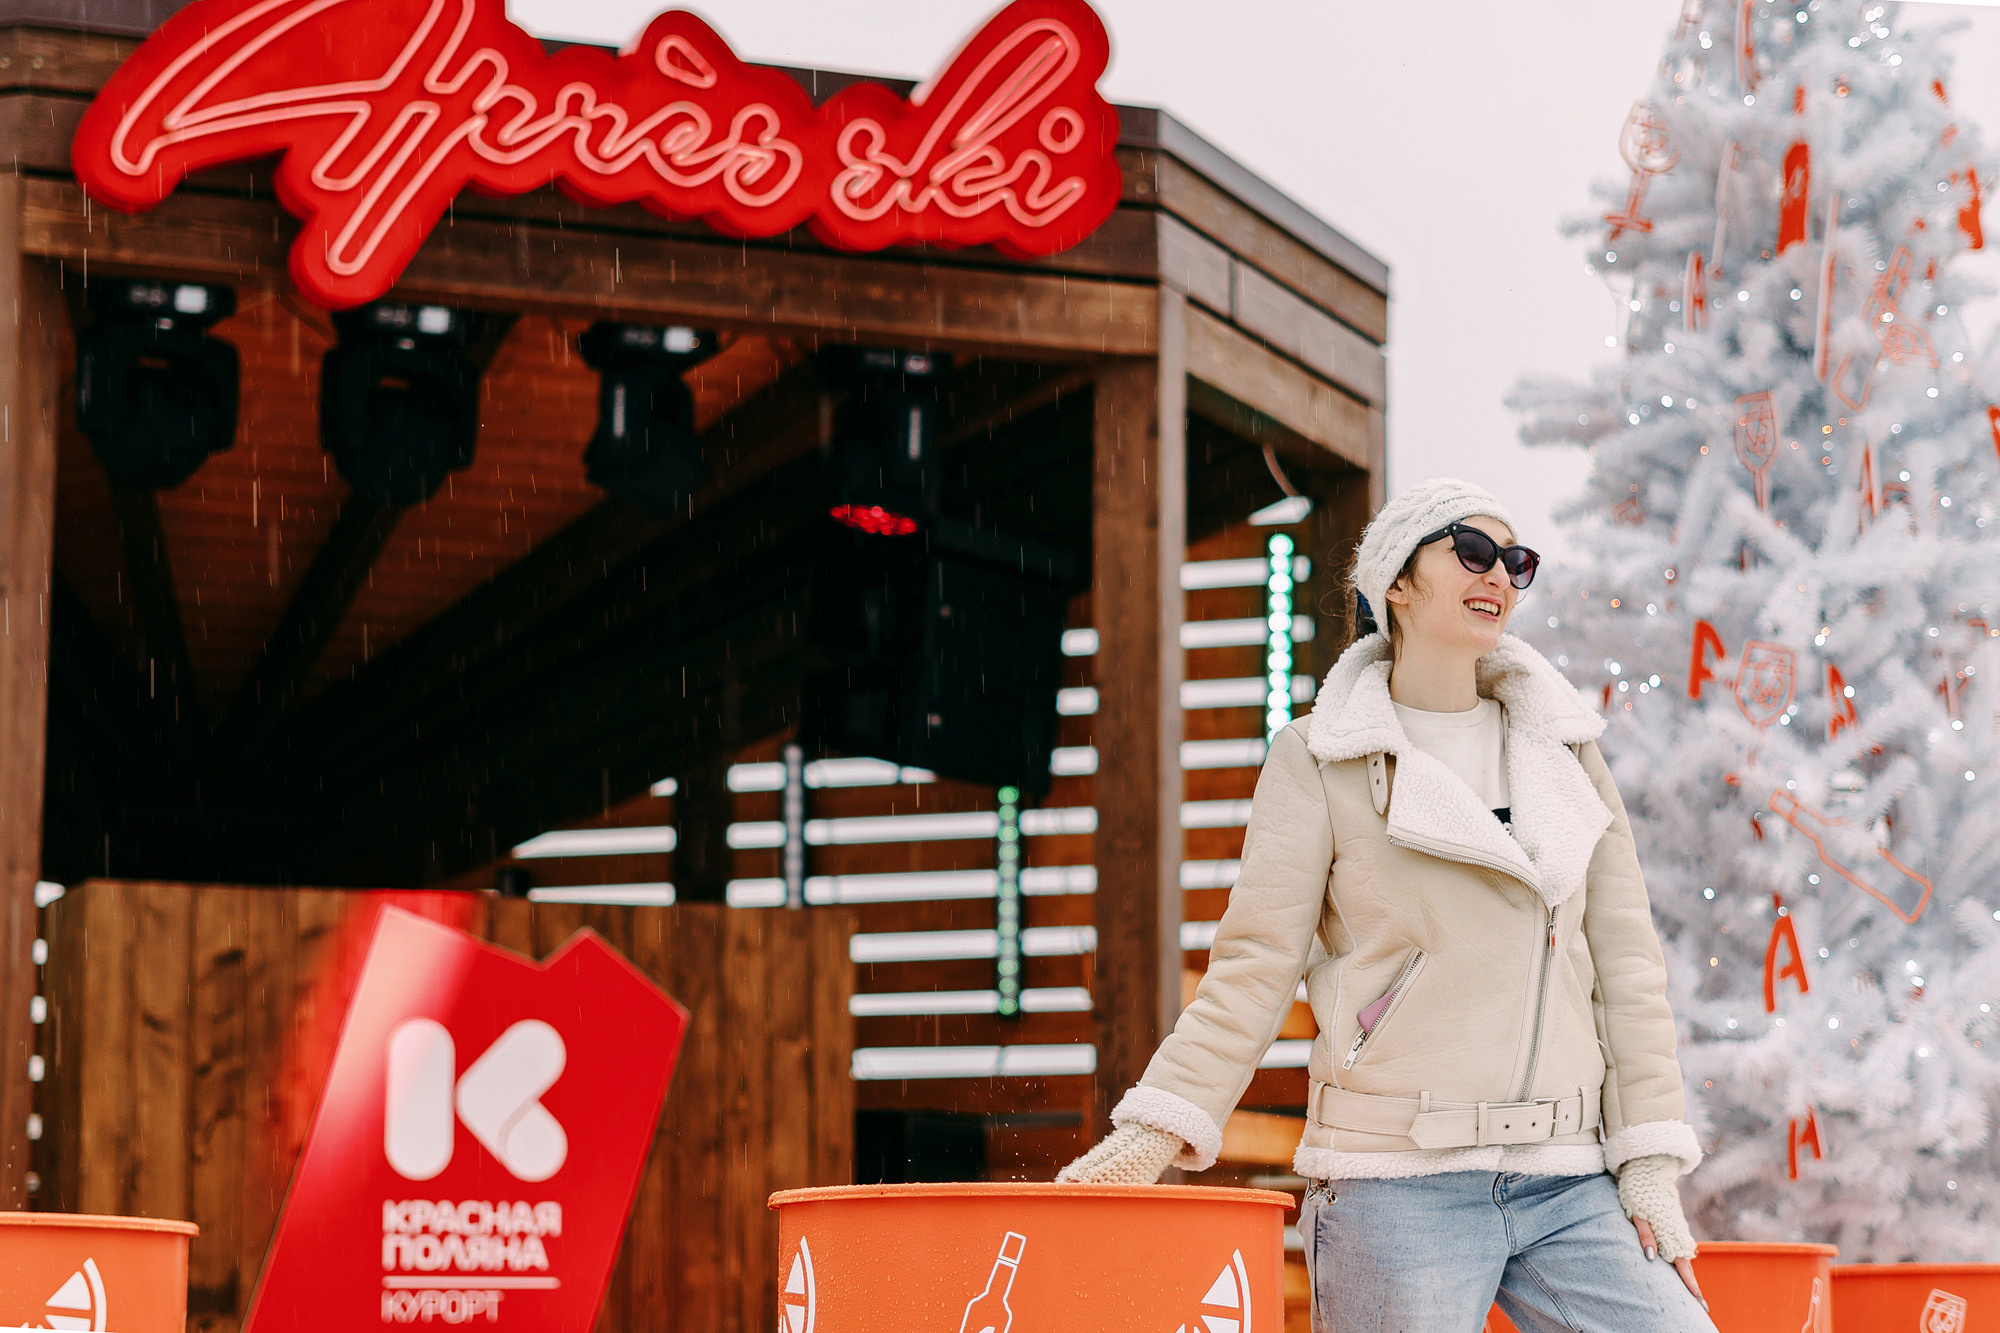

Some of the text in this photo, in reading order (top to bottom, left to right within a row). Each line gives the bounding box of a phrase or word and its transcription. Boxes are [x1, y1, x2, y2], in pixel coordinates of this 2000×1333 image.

[831, 18, 1087, 227] ski
[382, 1199, 562, 1237] КРАСНАЯ
[382, 1234, 549, 1271] ПОЛЯНА
[381, 1289, 505, 1324] КУРОРТ
